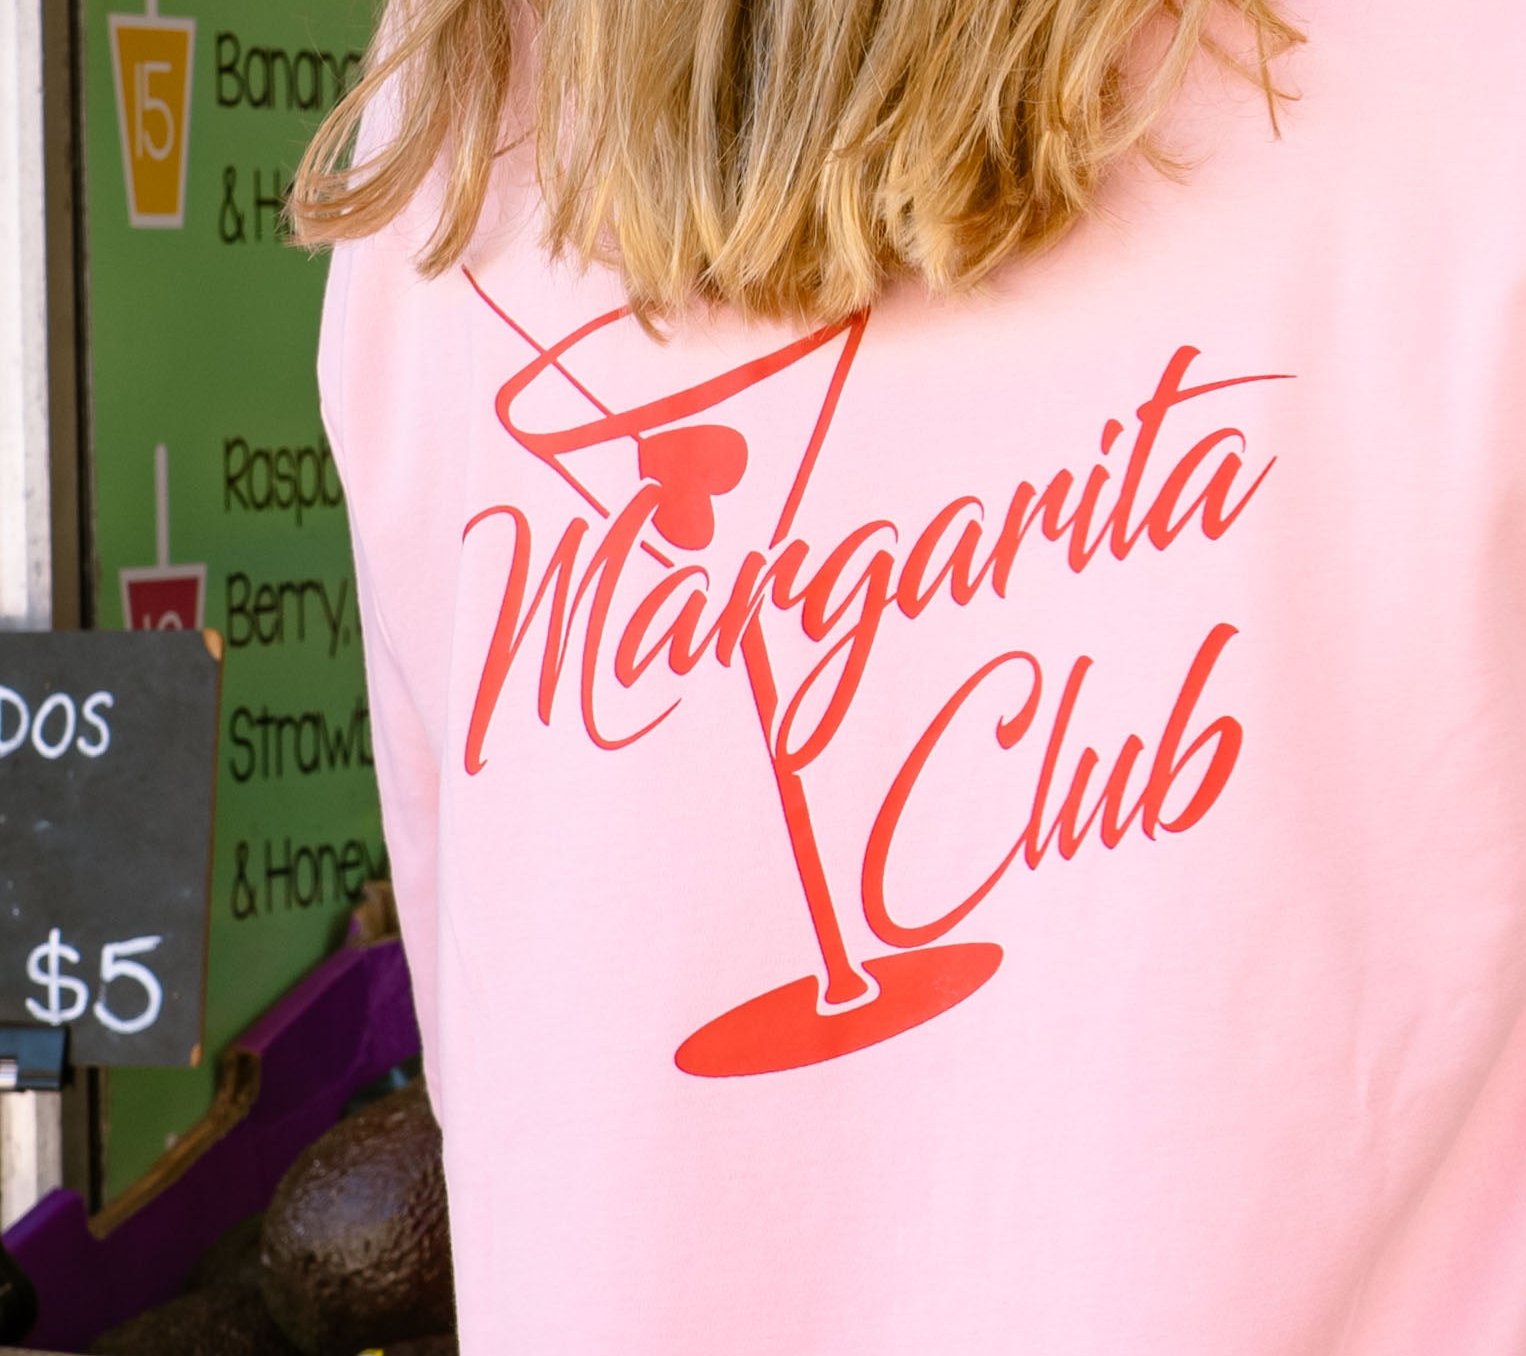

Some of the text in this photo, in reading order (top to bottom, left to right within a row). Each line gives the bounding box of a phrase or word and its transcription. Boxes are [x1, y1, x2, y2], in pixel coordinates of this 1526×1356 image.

[135, 60, 175, 162] 15
[218, 165, 246, 244] &
[462, 345, 1297, 775] Margarita
[861, 623, 1244, 948] Club
[231, 840, 257, 921] &
[26, 928, 163, 1034] $5
